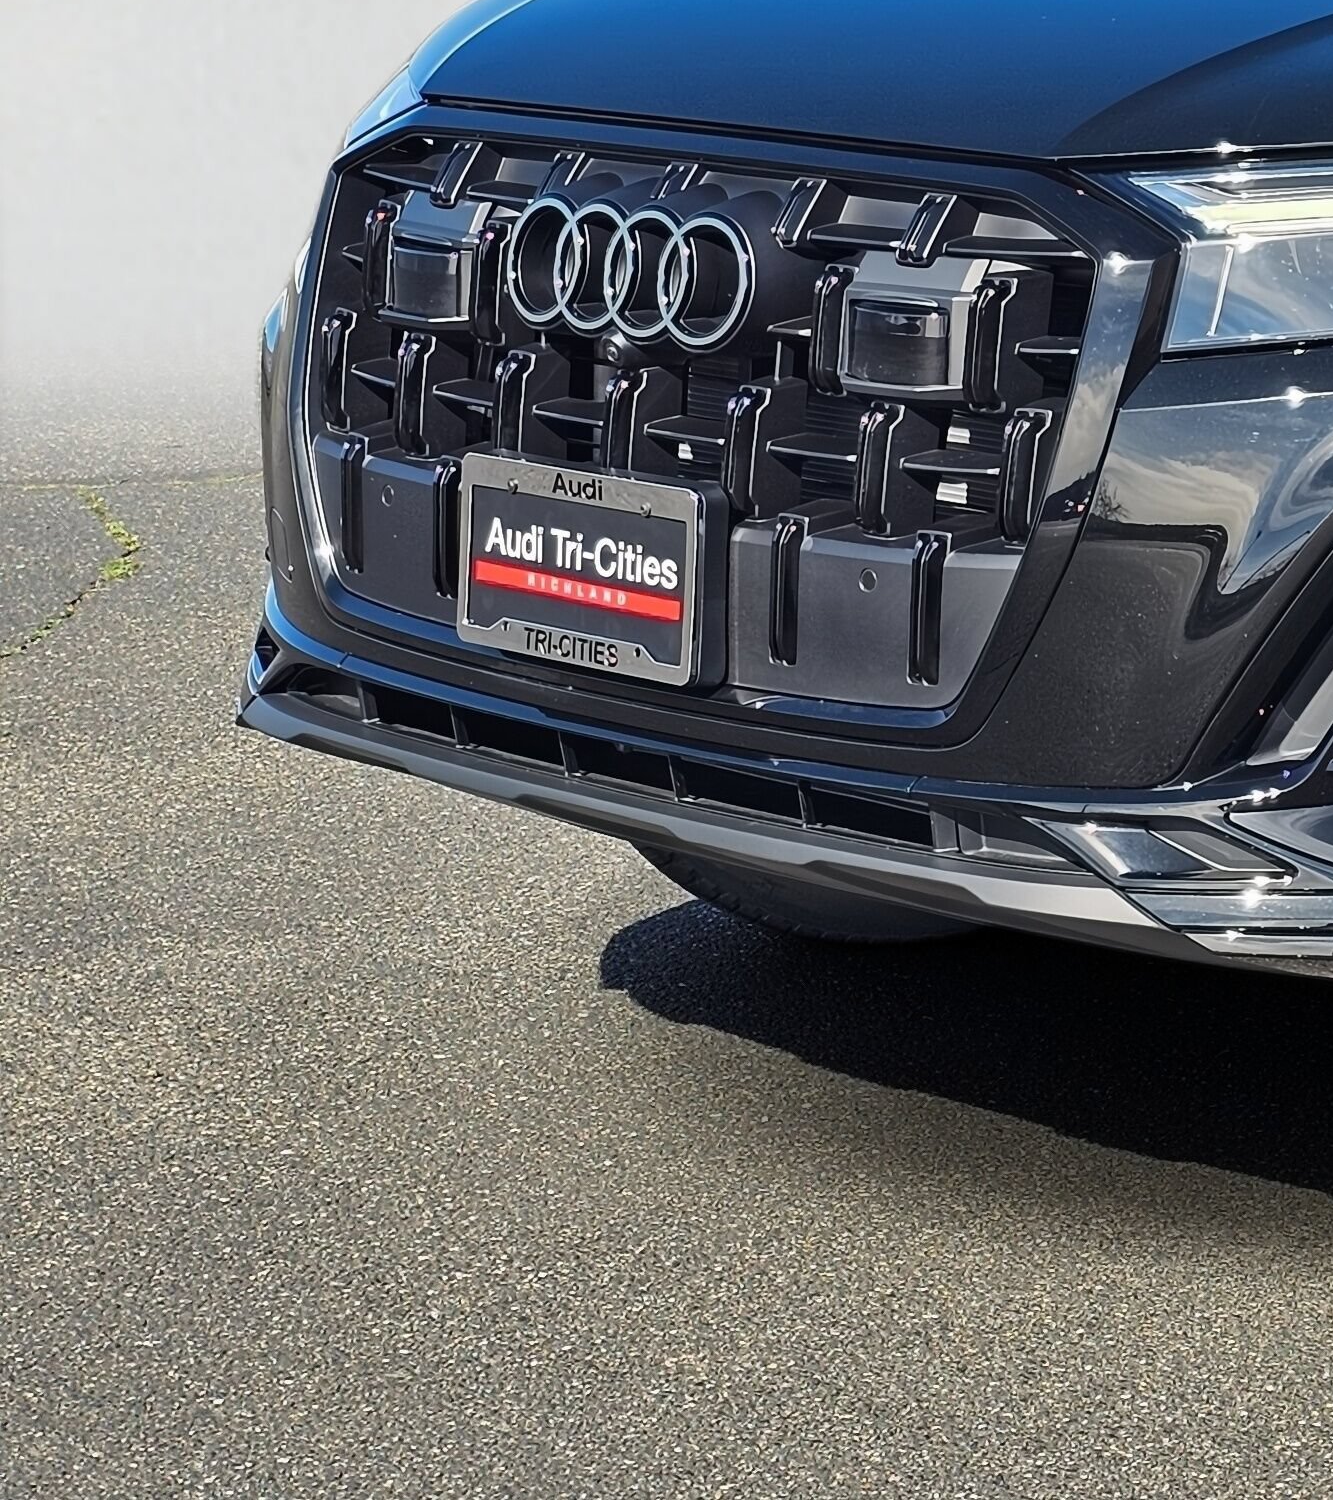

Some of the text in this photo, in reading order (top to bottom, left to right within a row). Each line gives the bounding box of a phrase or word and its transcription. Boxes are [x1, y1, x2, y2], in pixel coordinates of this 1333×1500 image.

[552, 472, 604, 501] Audi
[484, 516, 679, 590] Audi Tri-Cities
[526, 573, 628, 606] RICHLAND
[523, 626, 619, 668] TRI-CITIES
